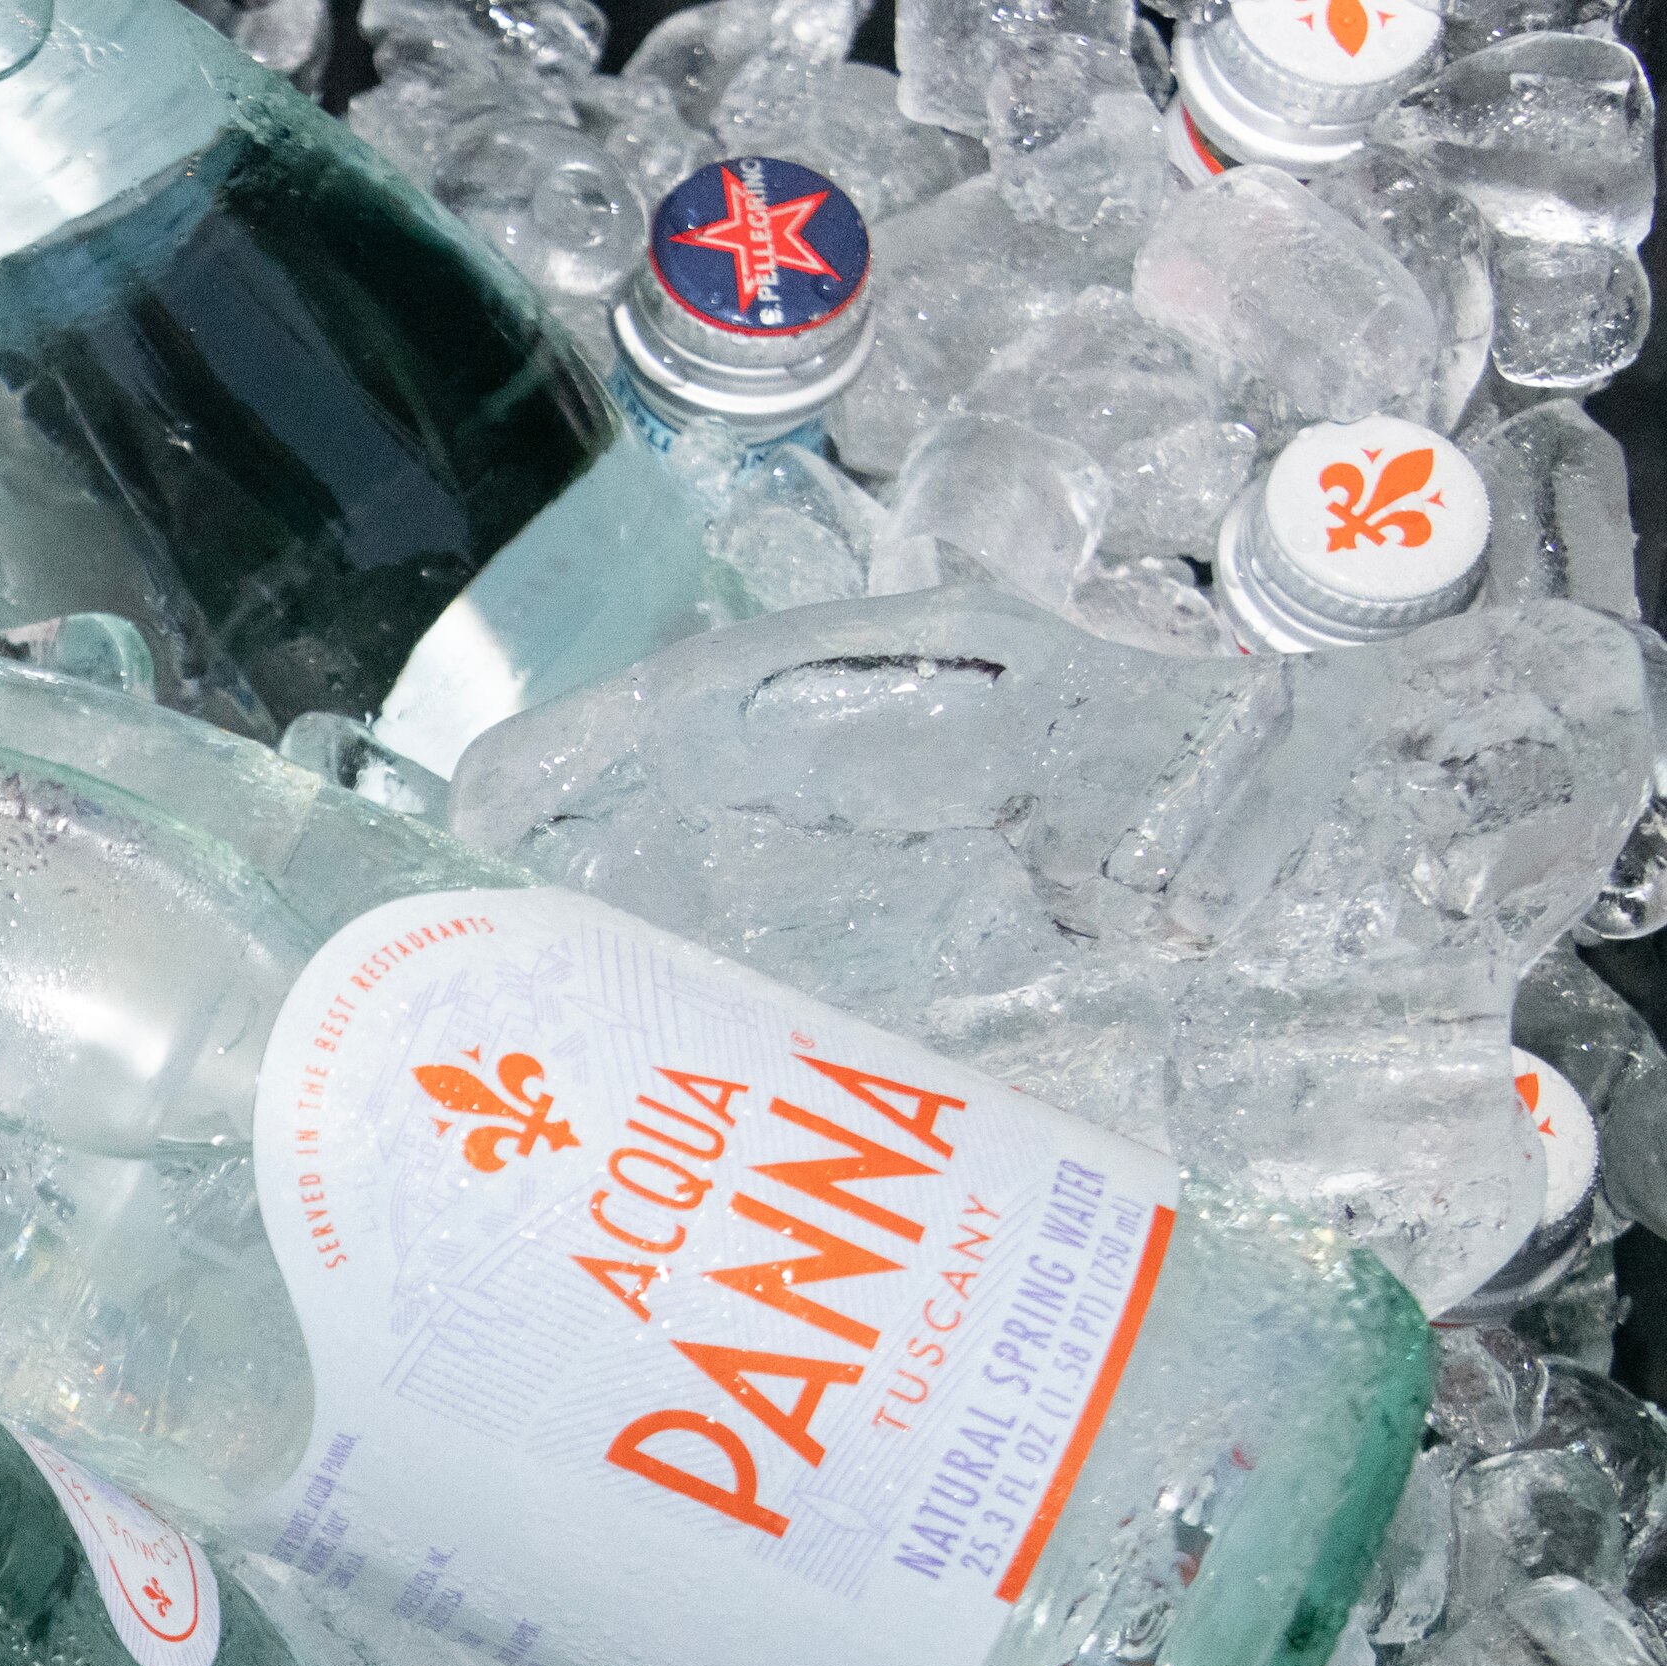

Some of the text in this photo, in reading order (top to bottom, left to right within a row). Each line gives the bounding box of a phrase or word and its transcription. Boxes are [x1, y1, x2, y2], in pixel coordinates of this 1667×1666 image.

[739, 157, 786, 326] S.PELLEGRINO
[295, 915, 495, 1270] SERVED IN THE BEST RESTAURANTS
[569, 1065, 749, 1323] ACQUA
[604, 1052, 967, 1539] PANNA
[873, 1193, 1000, 1432] TUSCANY
[894, 1158, 1107, 1579] NATURAL SPRING WATER
[961, 1195, 1146, 1578] 25.3 FL OZ (1.58 PT) (750 mL)
